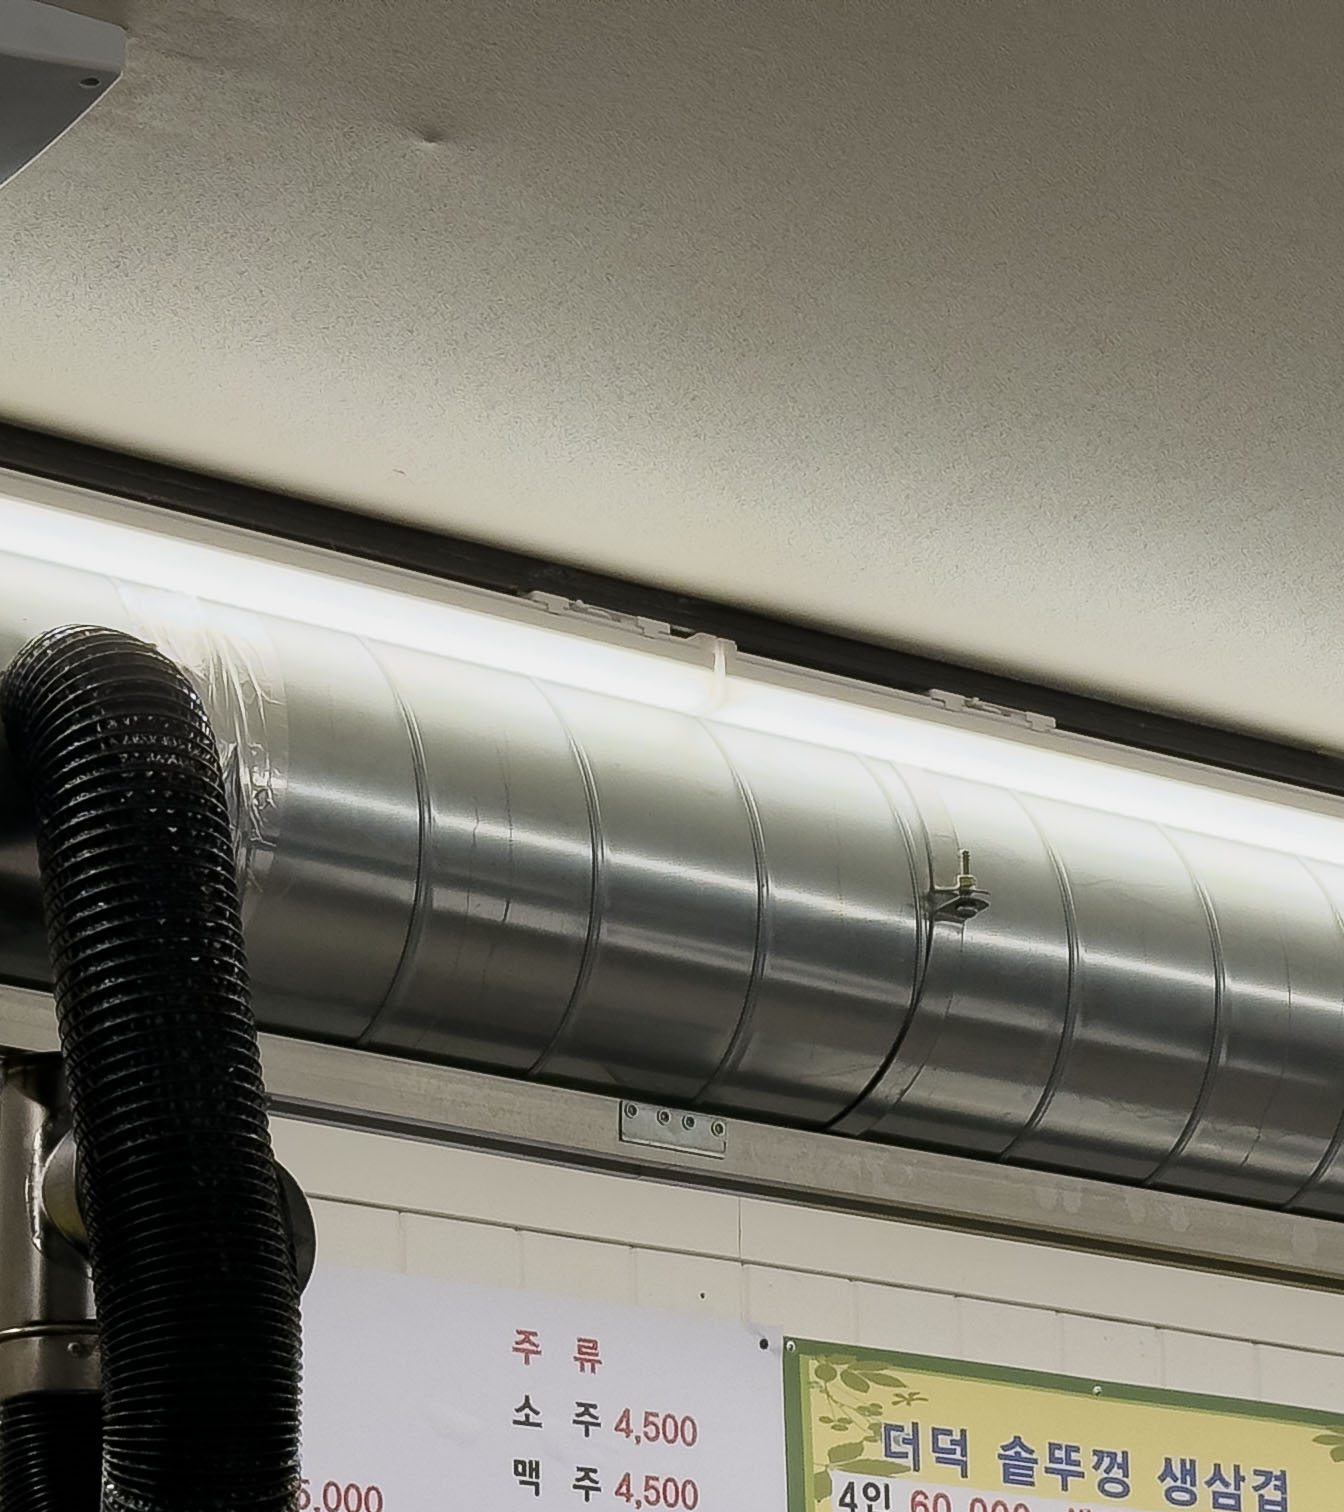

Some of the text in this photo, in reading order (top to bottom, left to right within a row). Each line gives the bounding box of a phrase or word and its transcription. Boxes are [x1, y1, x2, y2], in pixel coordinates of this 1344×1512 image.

[614, 1408, 697, 1447] 4,500
[883, 1421, 968, 1479] 더덕
[997, 1436, 1130, 1499] 솥뚜껑
[614, 1472, 698, 1510] 4,500
